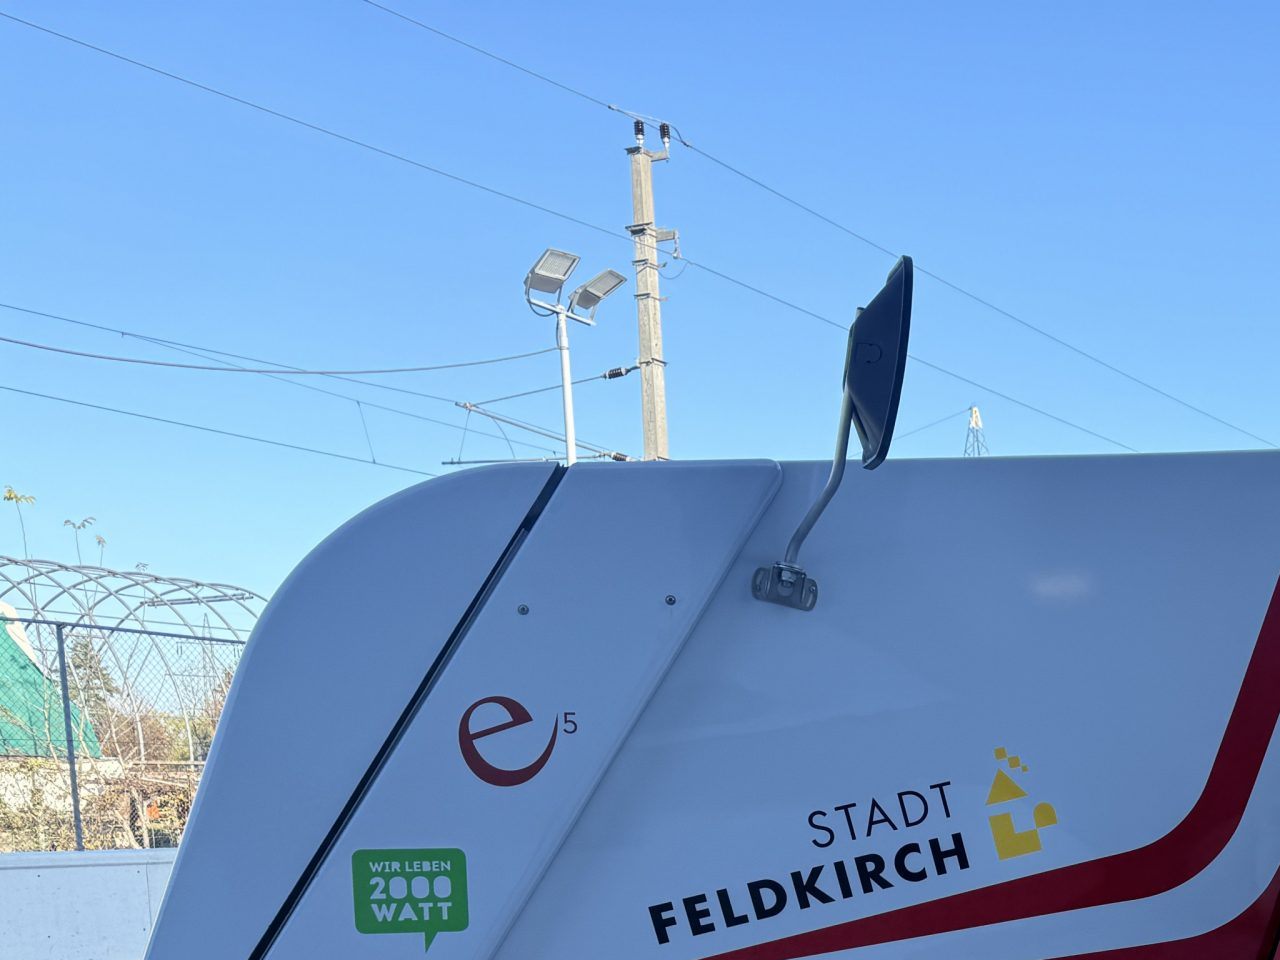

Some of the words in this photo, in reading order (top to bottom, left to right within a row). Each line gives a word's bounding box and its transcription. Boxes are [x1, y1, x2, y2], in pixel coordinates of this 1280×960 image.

[807, 780, 952, 849] STADT
[368, 861, 401, 873] WIR
[404, 860, 451, 873] LEBEN
[369, 875, 452, 900] 2000
[648, 831, 971, 946] FELDKIRCH
[370, 901, 453, 922] WATT
